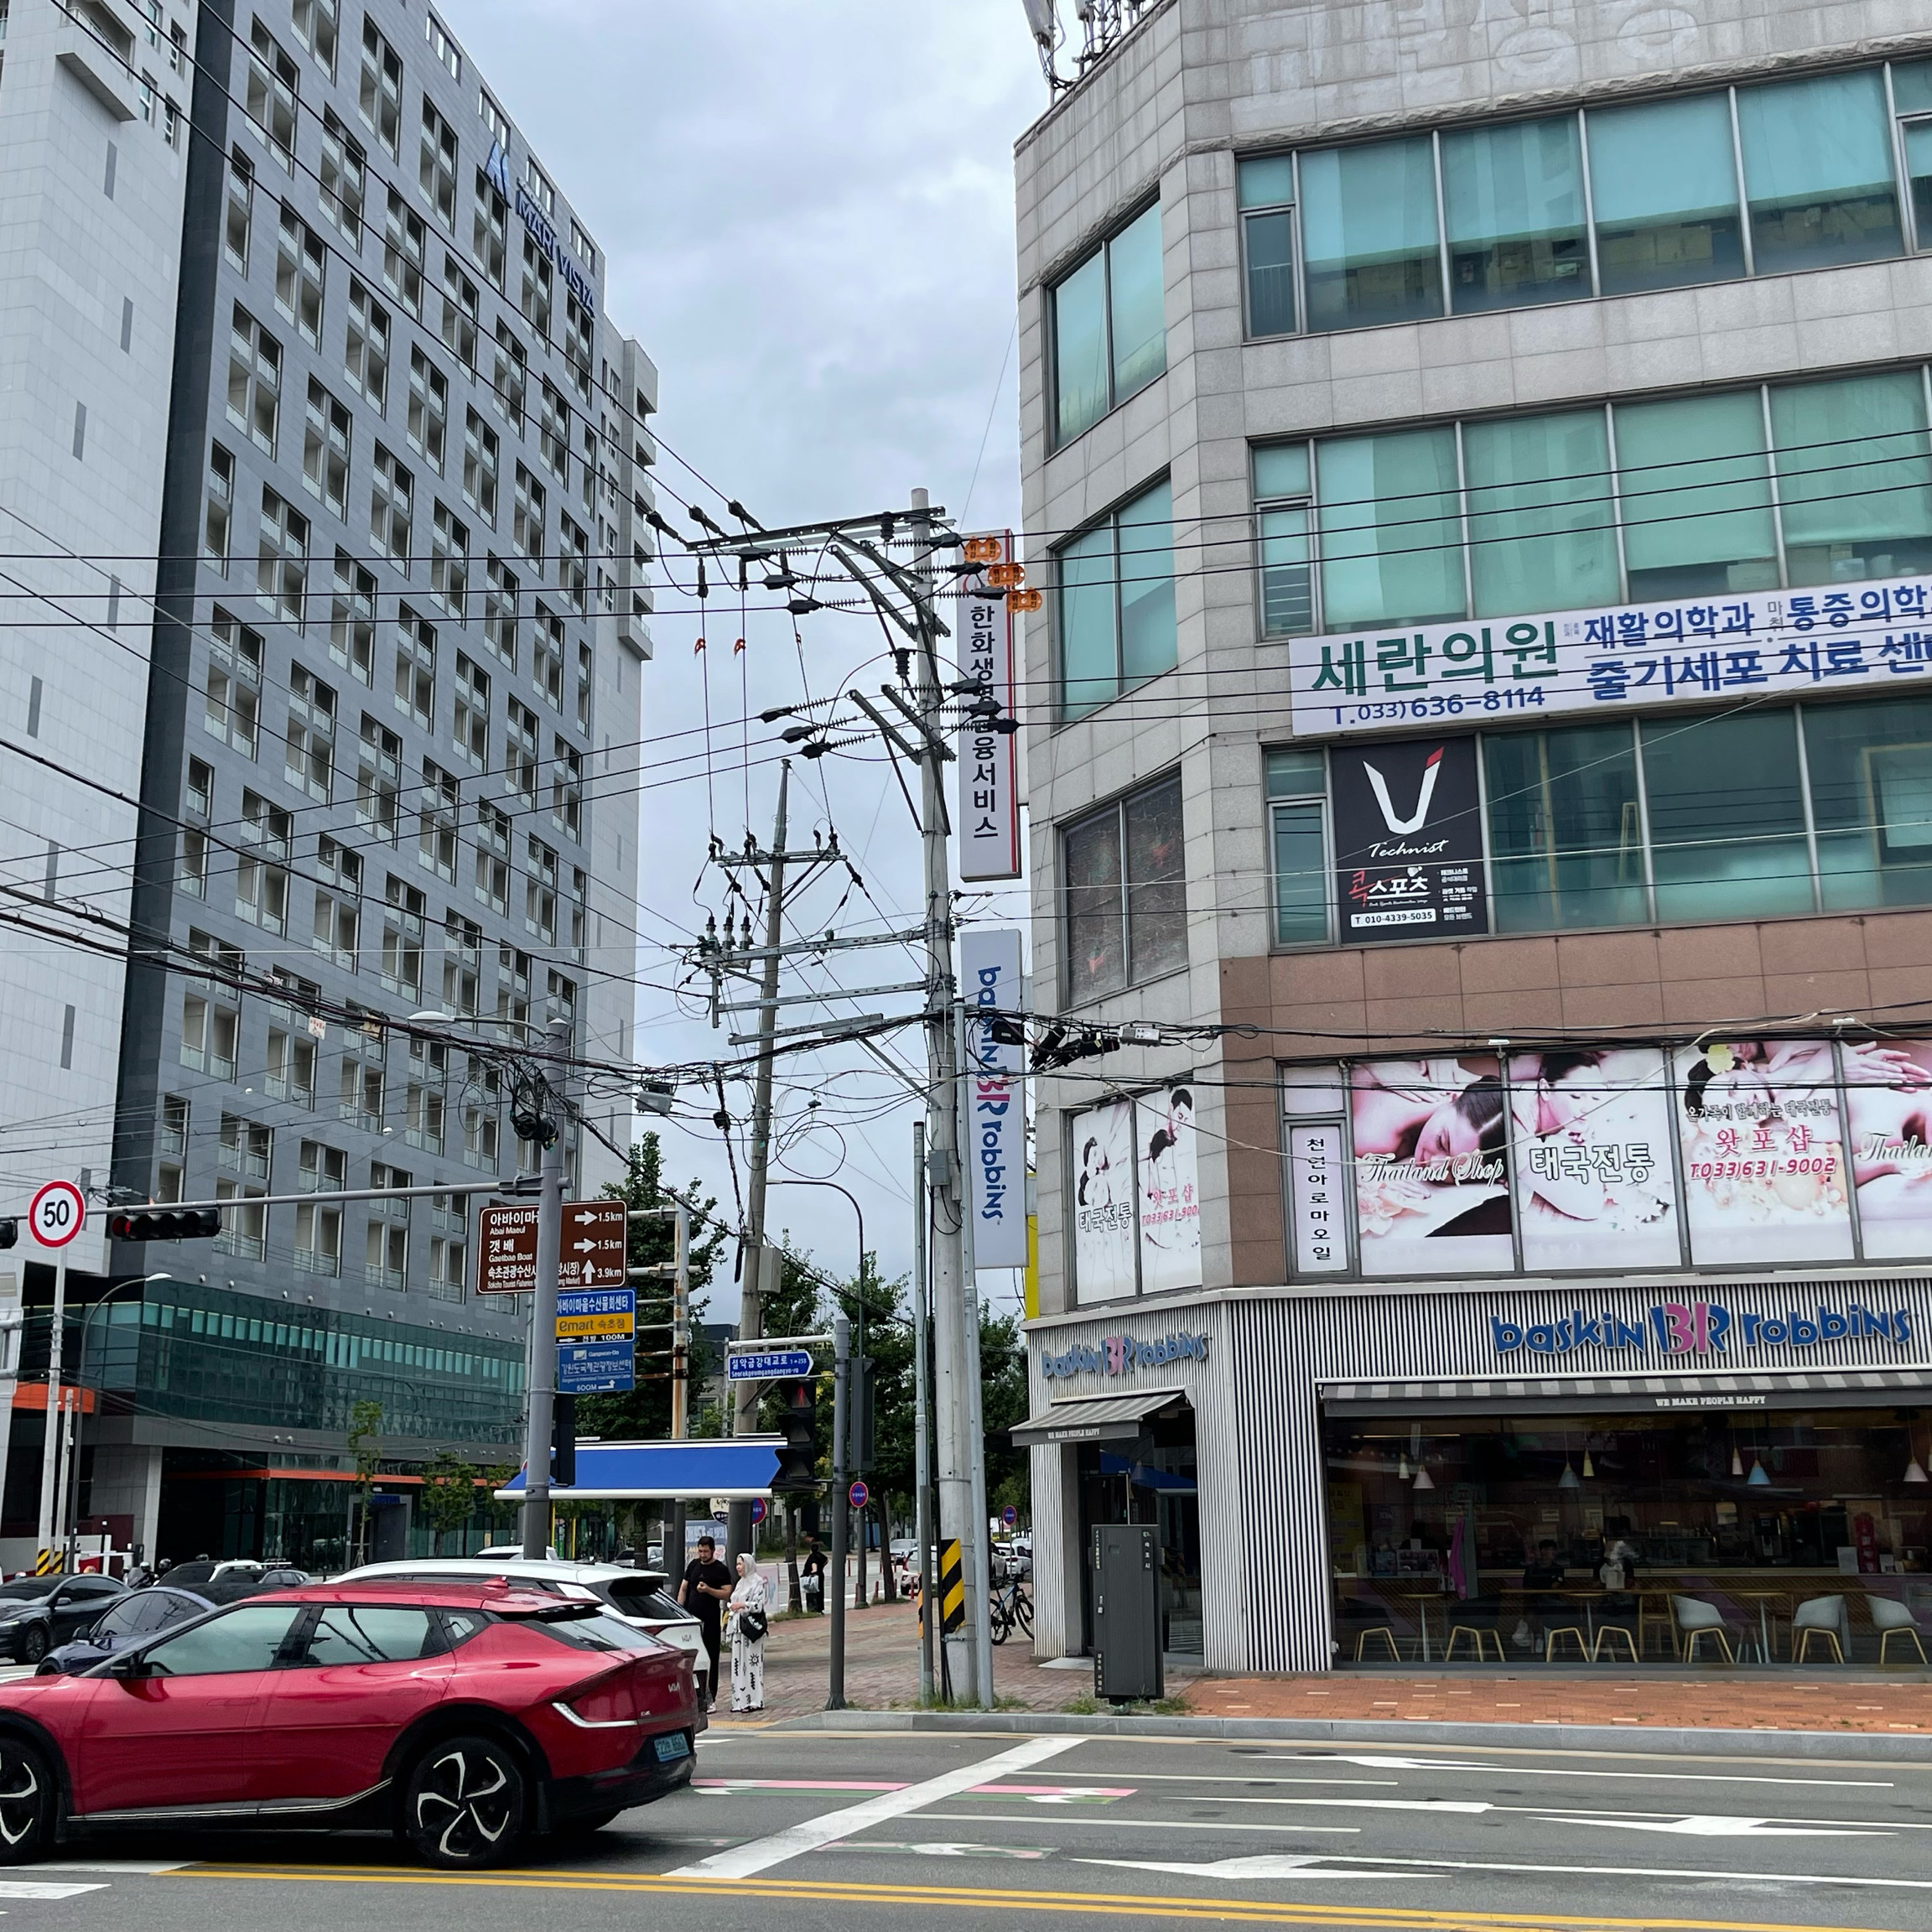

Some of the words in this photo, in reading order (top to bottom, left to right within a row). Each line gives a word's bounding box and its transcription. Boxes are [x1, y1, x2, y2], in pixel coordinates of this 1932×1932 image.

[516, 190, 554, 262] MARI
[557, 244, 595, 319] VISTA
[1583, 602, 1756, 650] 재활의학과
[1786, 584, 1932, 632] 통증의학
[1311, 621, 1559, 697] 세란의원
[1586, 649, 1768, 701] 줄기세포
[1779, 640, 1870, 683] 치료
[969, 605, 999, 839] 한화생융서비스
[1368, 839, 1449, 858] Technist
[1365, 911, 1433, 925] 010-4339-5035
[1687, 1103, 1733, 1122] 온가족이
[1784, 1098, 1833, 1119] 태국전통
[1360, 1152, 1449, 1182] Thailand
[1452, 1149, 1504, 1187] Shop
[1529, 1142, 1655, 1185] 태국전통
[43, 1199, 70, 1228] 50
[598, 1212, 623, 1222] 1.5km
[1078, 1201, 1133, 1233] 태국전통
[517, 1253, 533, 1261] Boat
[597, 1239, 622, 1250] 1.5km
[597, 1267, 622, 1279] 3.9km
[558, 1319, 595, 1332] emart
[597, 1317, 626, 1330] 속초점
[1647, 1301, 1732, 1356] BR
[731, 1355, 788, 1370] 설악금강대교로
[1655, 1398, 1670, 1407] WE
[1671, 1397, 1699, 1406] MAKE
[1700, 1396, 1735, 1405] PEOPLE
[1736, 1395, 1766, 1405] HAPPY
